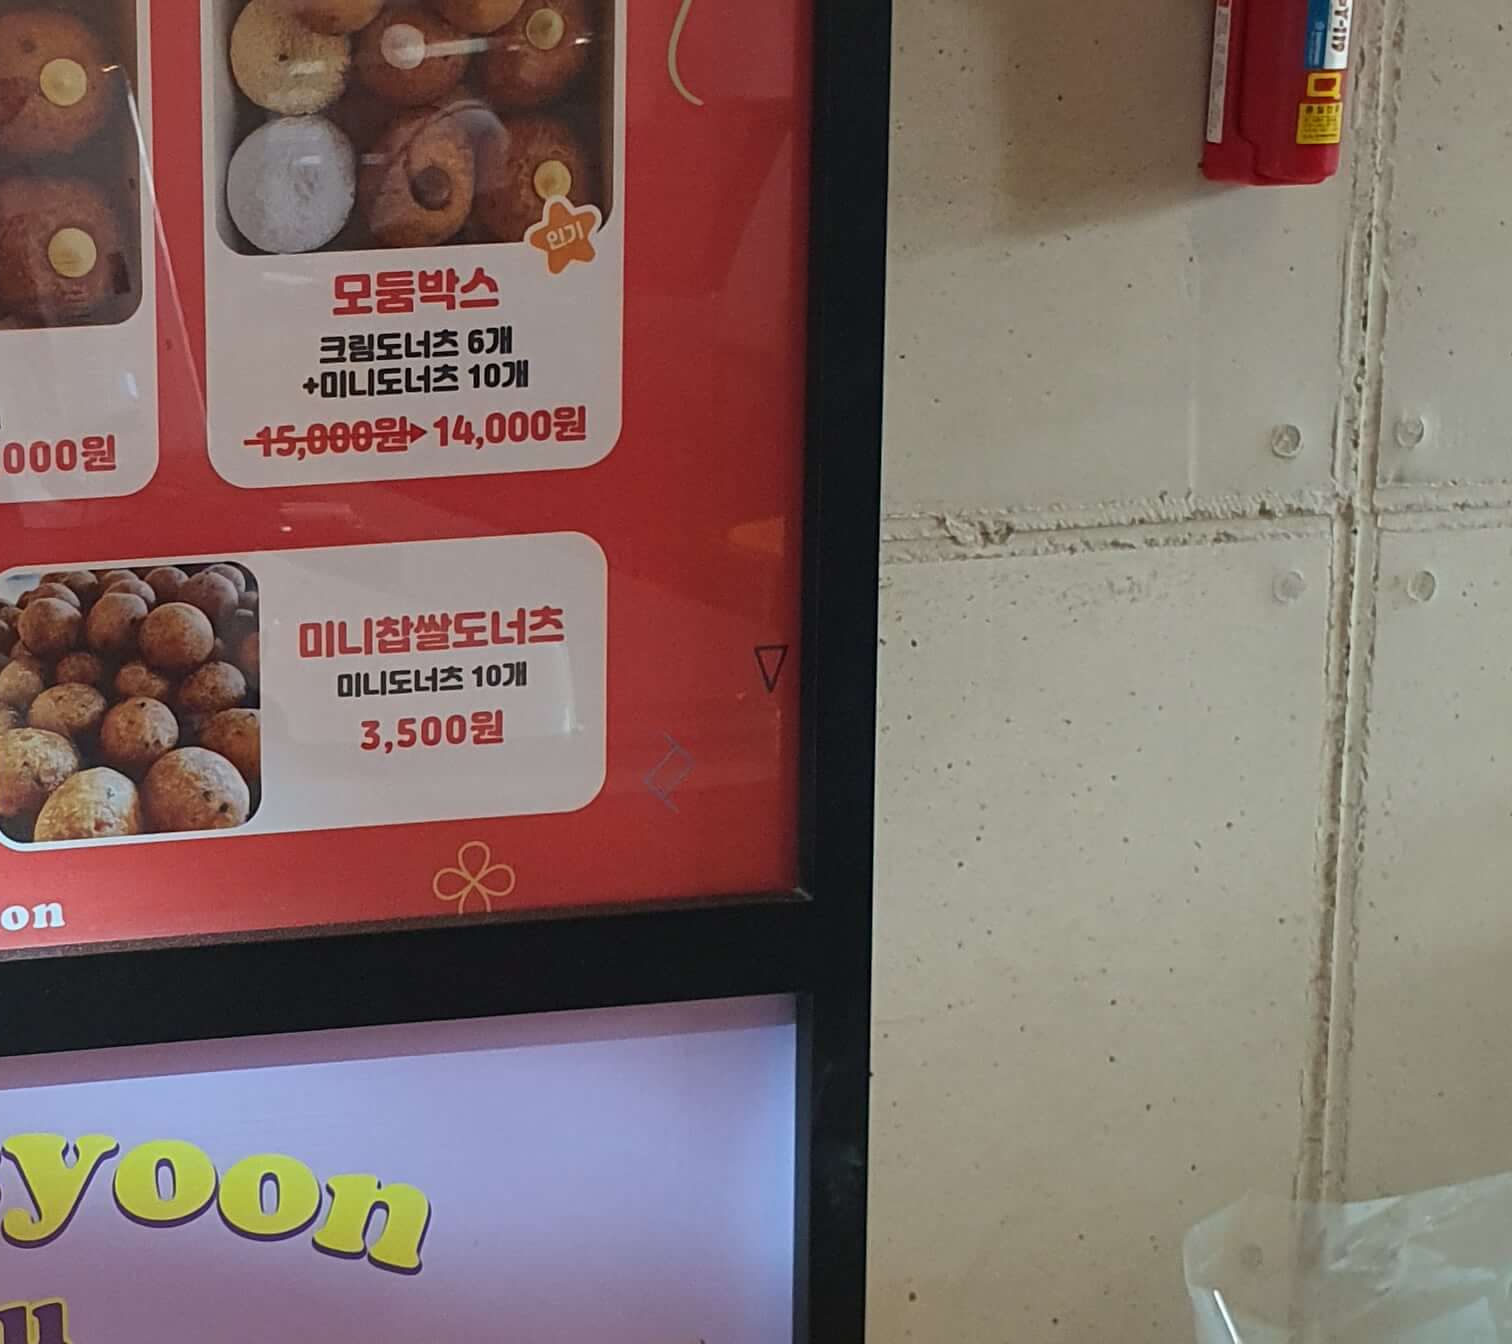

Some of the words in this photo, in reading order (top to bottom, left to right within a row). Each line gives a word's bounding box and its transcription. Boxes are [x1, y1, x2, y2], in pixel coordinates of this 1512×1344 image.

[545, 220, 584, 251] 인기
[332, 266, 500, 316] 모둠박스
[319, 328, 459, 364] 크림도너츠
[467, 325, 513, 355] 6개
[468, 359, 529, 390] 10개
[432, 405, 587, 450] 14,000원
[298, 605, 565, 658] 미니찹쌀도너츠
[336, 665, 464, 698] 미니도너츠
[471, 661, 527, 689] 10개
[359, 708, 505, 755] 3,500원
